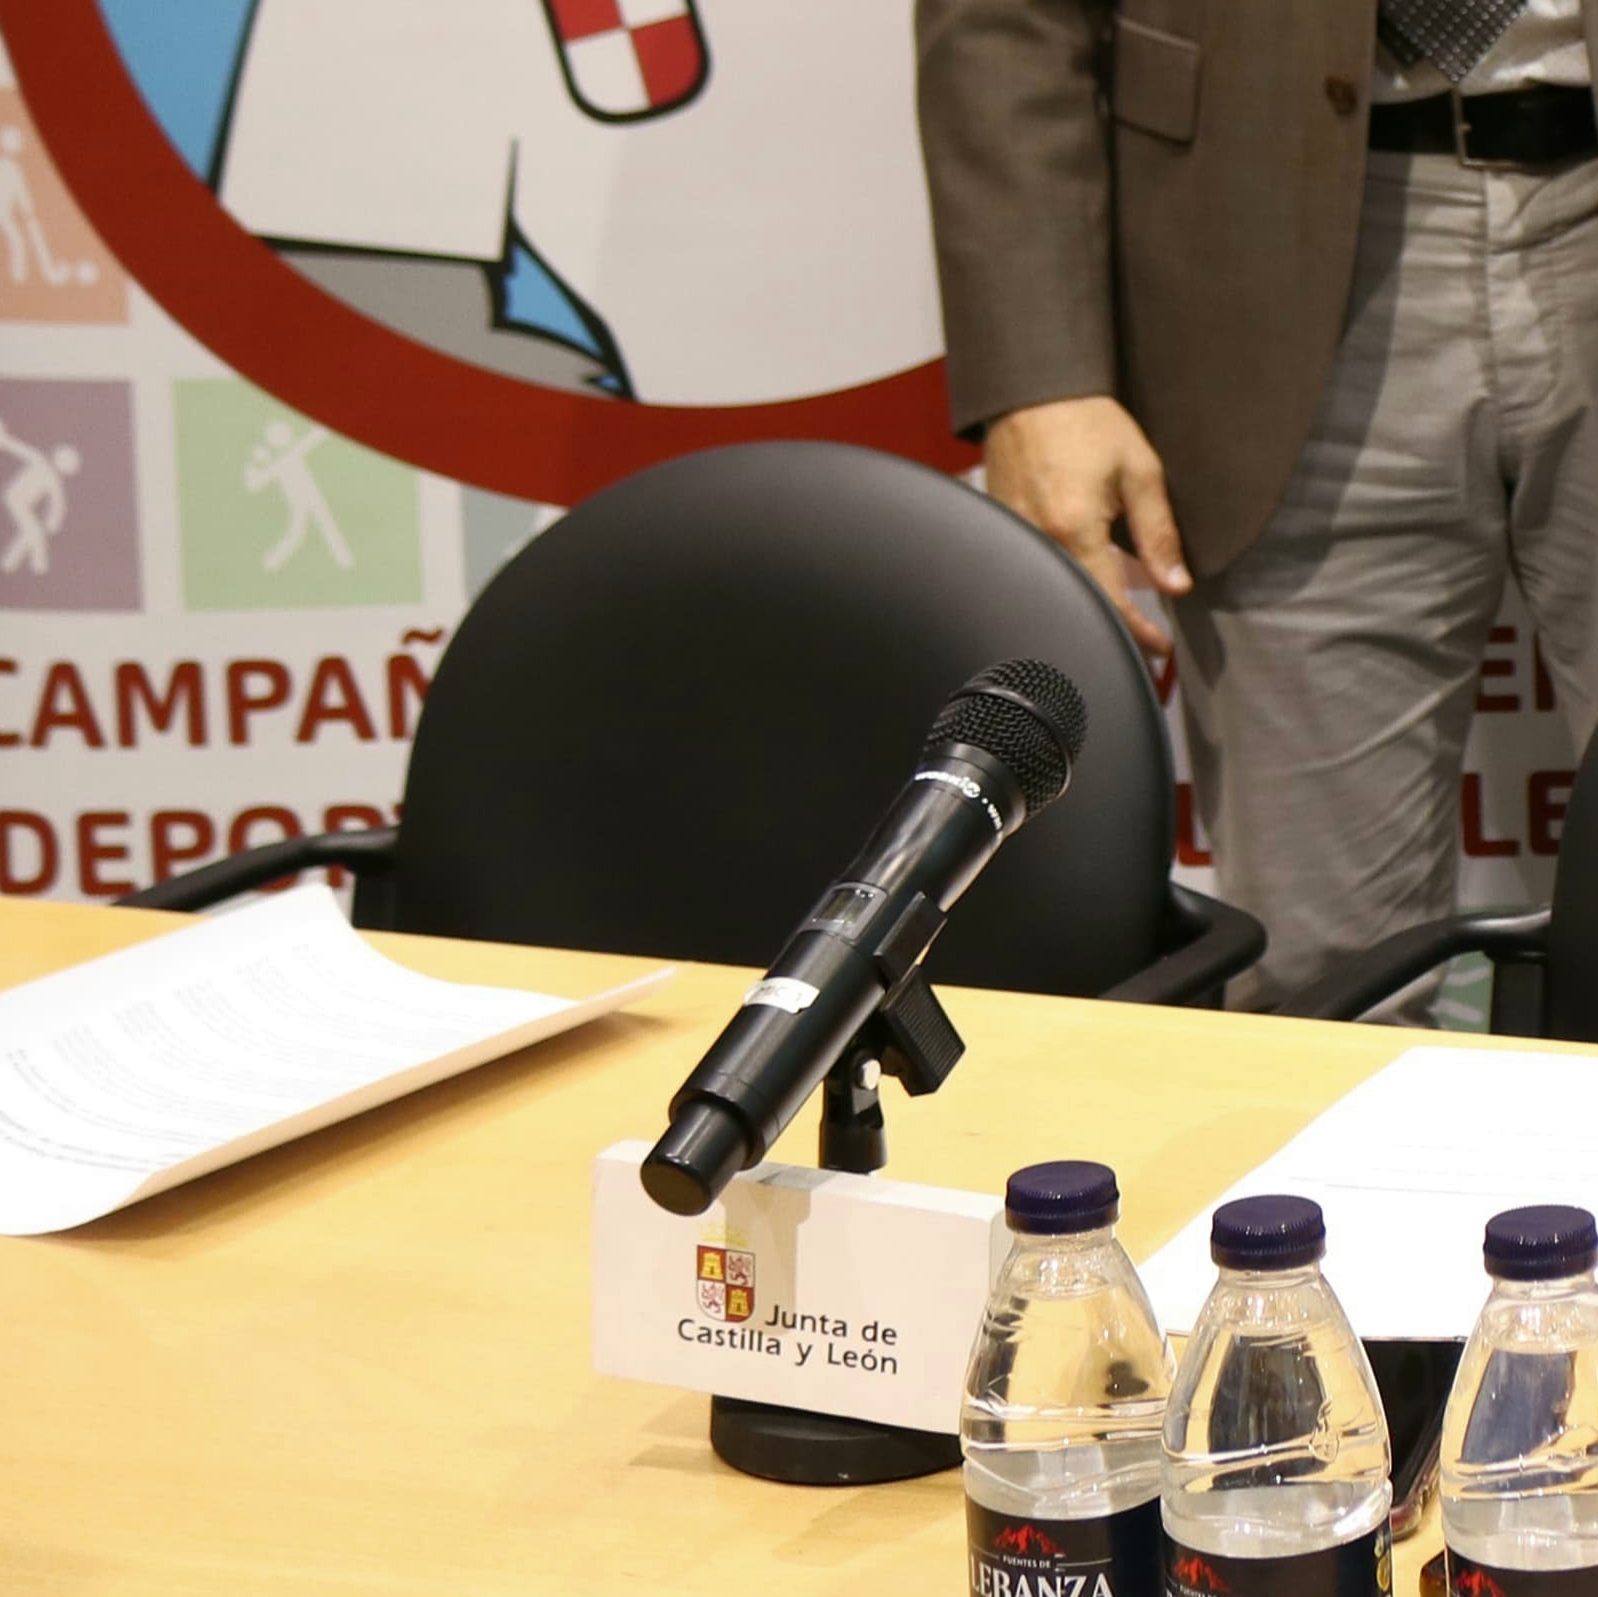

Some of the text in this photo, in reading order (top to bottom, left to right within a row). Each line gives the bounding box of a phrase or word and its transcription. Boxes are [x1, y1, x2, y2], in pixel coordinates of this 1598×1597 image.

[677, 1318, 899, 1375] Castilla y León
[763, 1304, 899, 1347] Junta de
[969, 1553, 1115, 1597] LEBANZA
[1003, 1554, 1051, 1569] FUENTES DE
